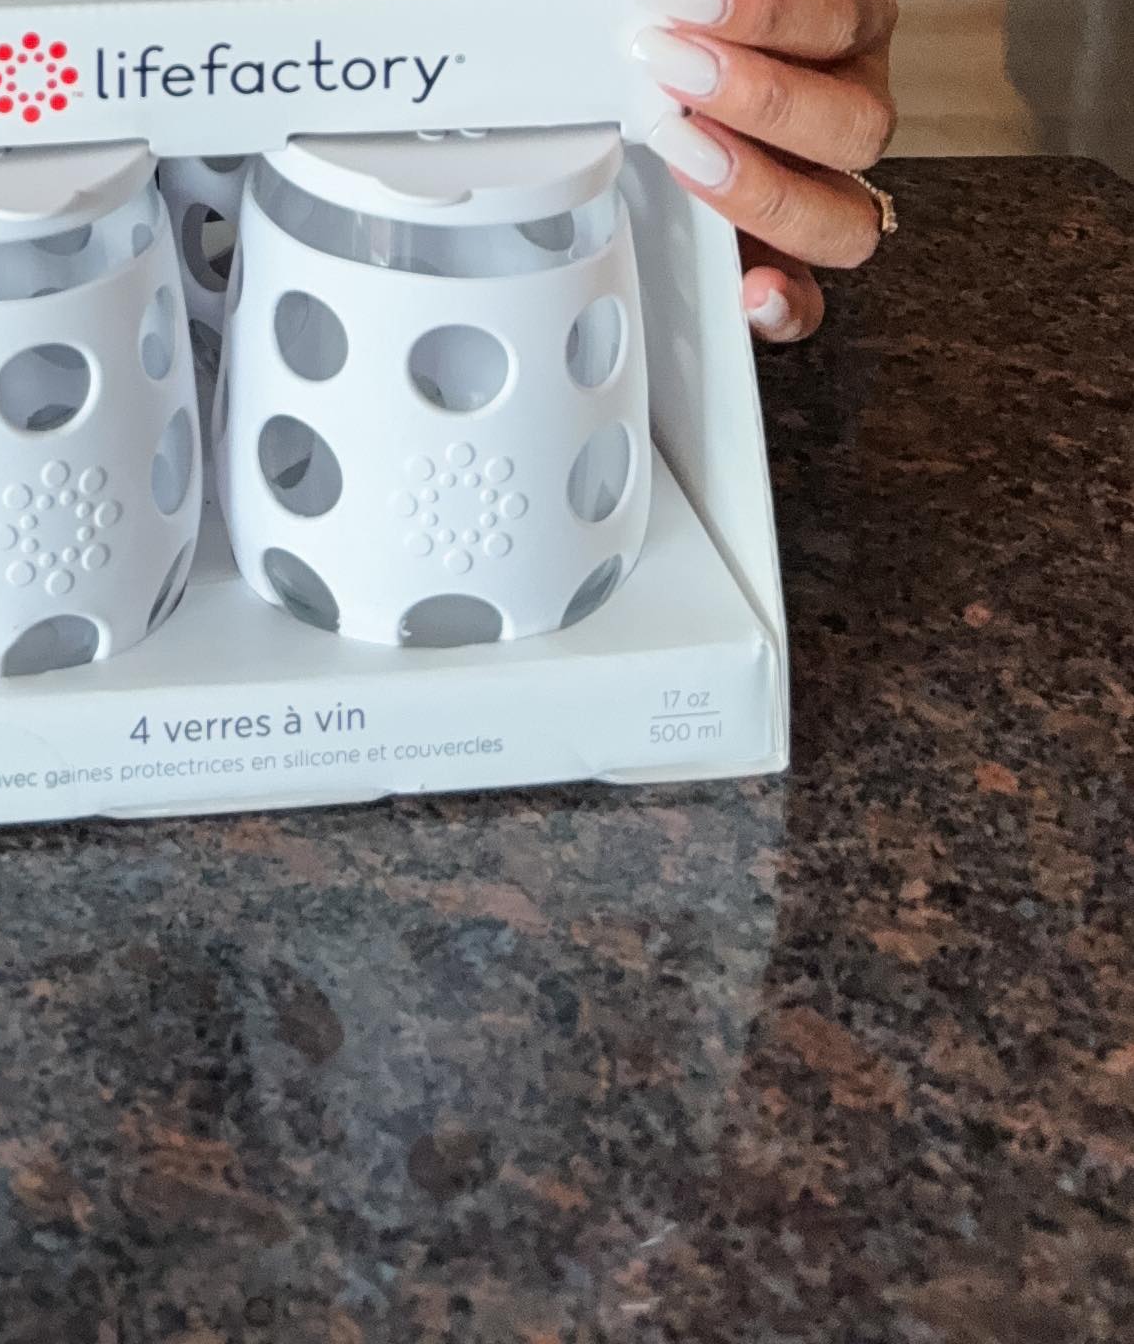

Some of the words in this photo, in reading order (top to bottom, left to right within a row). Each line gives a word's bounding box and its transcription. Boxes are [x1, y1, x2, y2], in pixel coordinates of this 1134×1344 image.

[96, 39, 450, 104] lifefactory
[662, 690, 682, 708] 17
[687, 691, 711, 708] oz
[129, 714, 151, 745] 4
[163, 713, 272, 744] verres
[283, 704, 302, 736] à
[314, 701, 366, 733] vin
[649, 722, 691, 744] 500
[697, 720, 723, 739] ml
[44, 765, 114, 791] gaines
[120, 754, 245, 783] protectrices
[251, 754, 277, 772] en
[283, 747, 361, 769] silicone
[367, 743, 387, 762] et
[394, 735, 504, 762] couvercles
